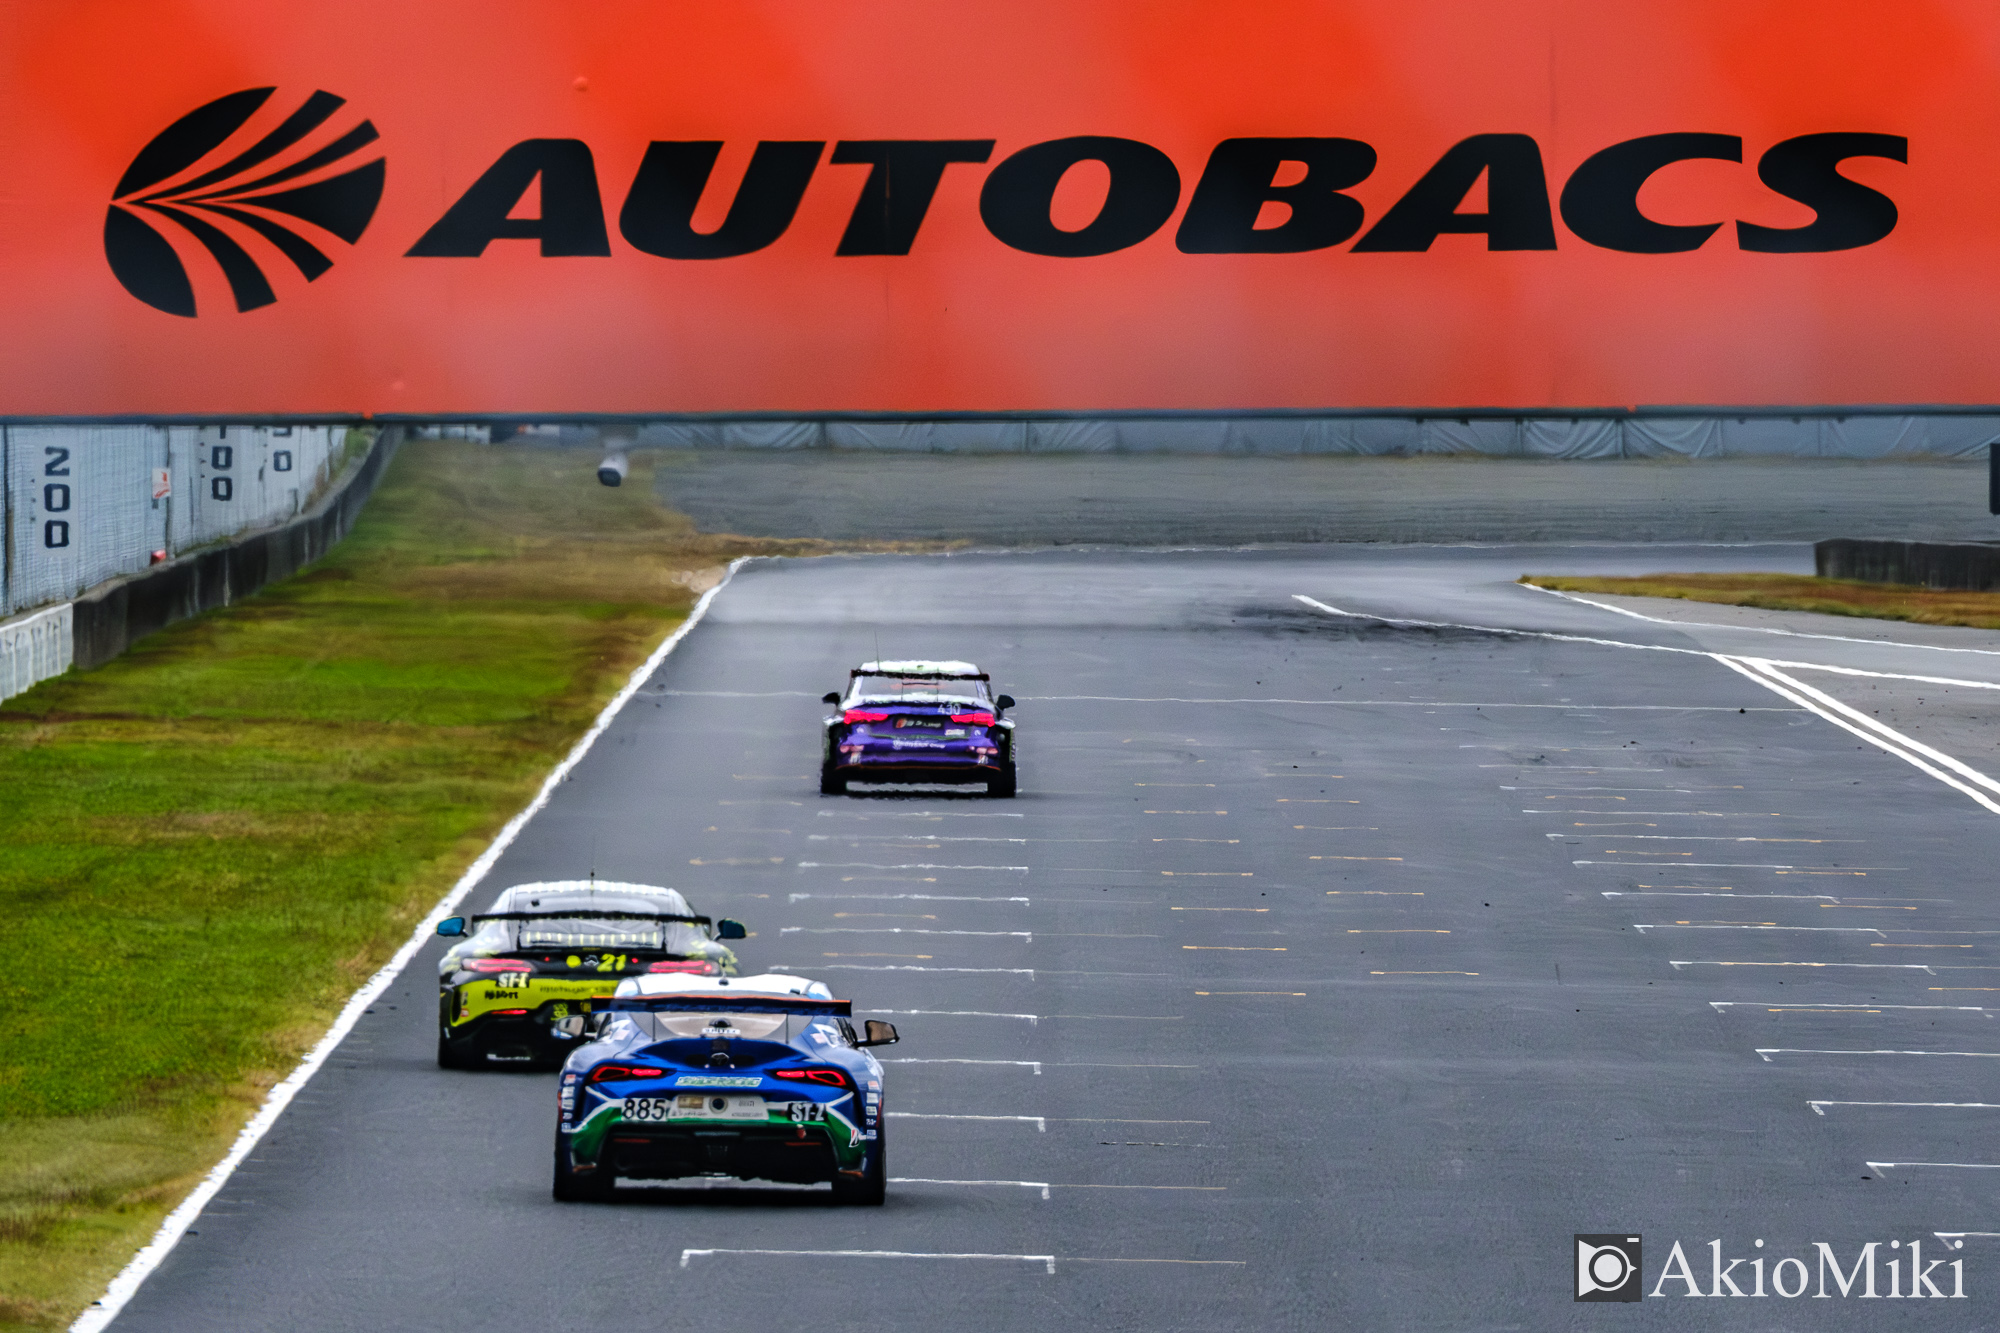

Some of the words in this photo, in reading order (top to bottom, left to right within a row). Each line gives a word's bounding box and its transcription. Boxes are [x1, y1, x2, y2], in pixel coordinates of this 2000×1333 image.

[404, 131, 1909, 259] AUTOBACS
[44, 446, 71, 549] 200
[937, 703, 962, 716] 430
[596, 953, 627, 973] 21
[622, 1098, 667, 1120] 885
[791, 1102, 826, 1122] ST-Z
